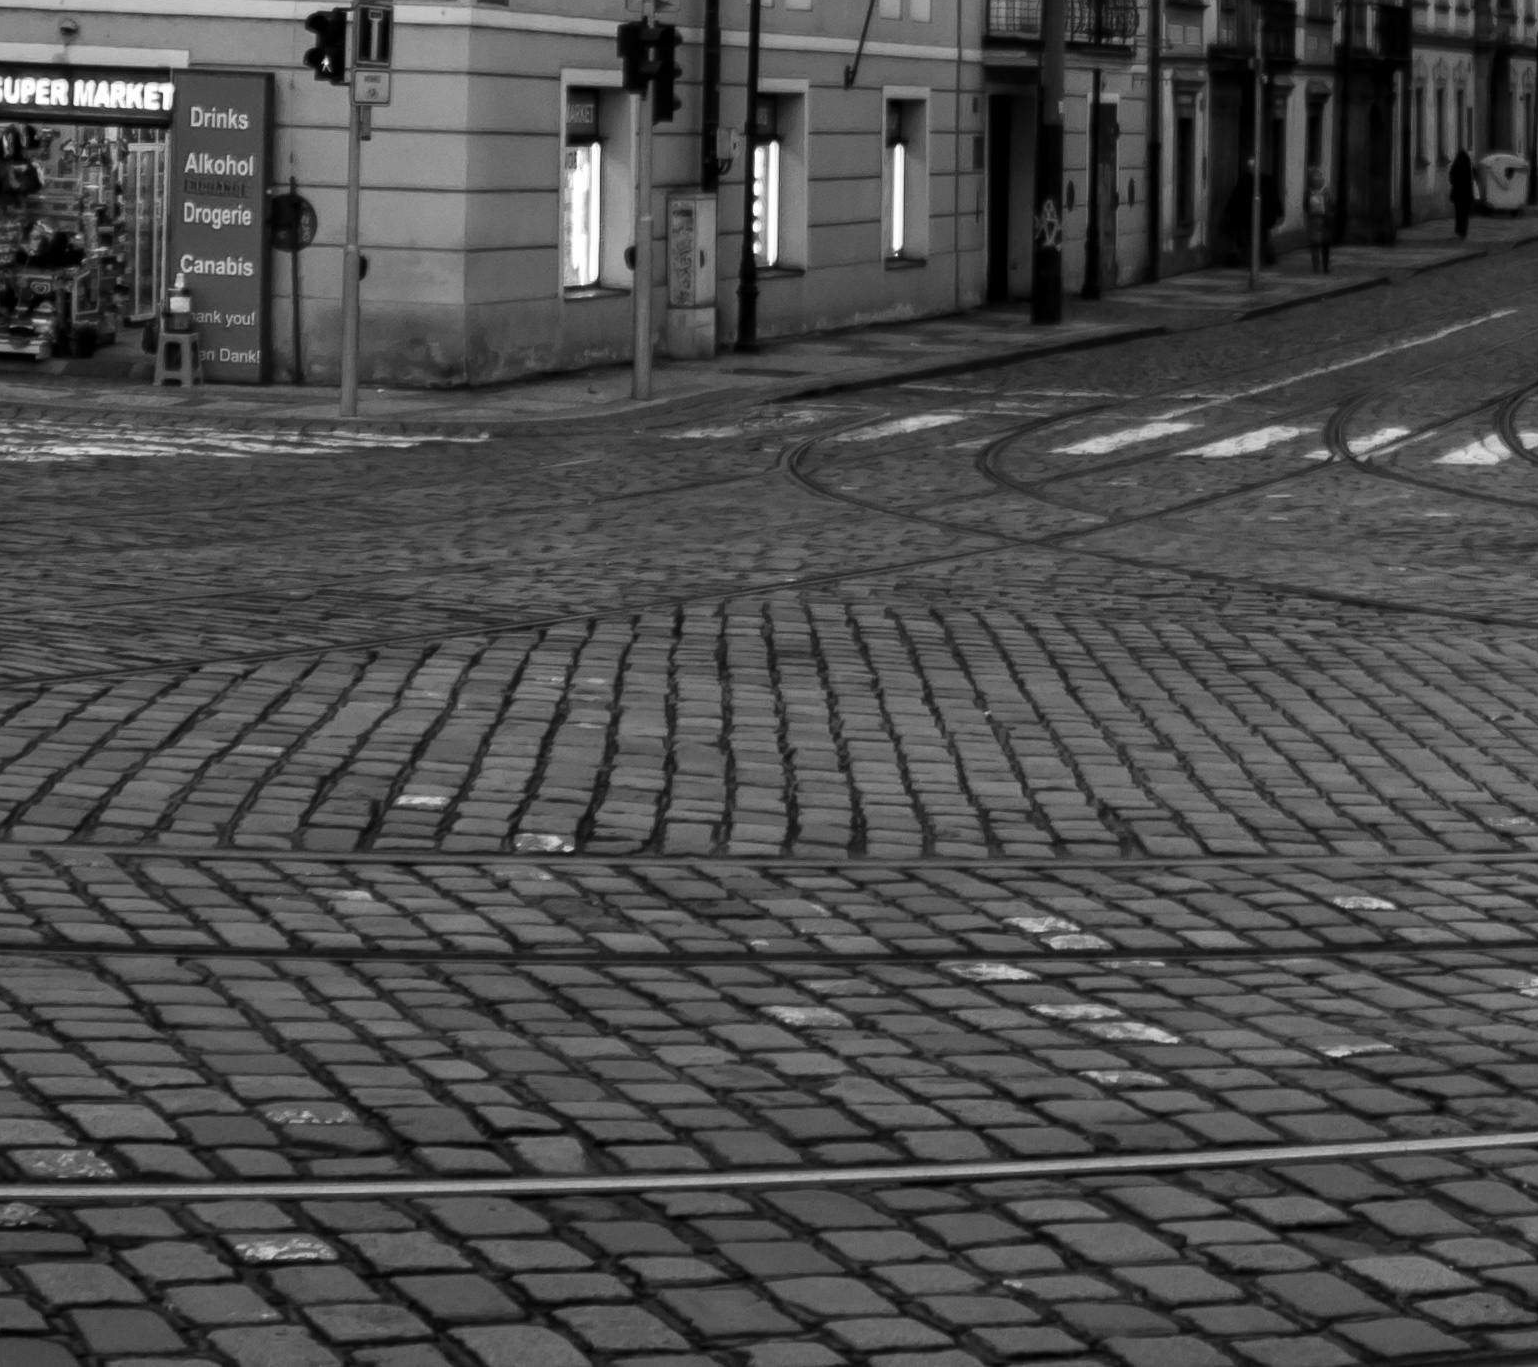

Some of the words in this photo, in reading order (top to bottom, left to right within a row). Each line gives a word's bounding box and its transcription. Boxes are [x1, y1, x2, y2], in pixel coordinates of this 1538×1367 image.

[73, 79, 175, 111] MARKET
[190, 106, 248, 130] Drinks
[184, 152, 254, 176] Alkohol
[184, 202, 252, 229] Drogerie
[180, 254, 254, 276] Canabis
[226, 311, 255, 327] you!
[220, 348, 260, 364] Dank!
